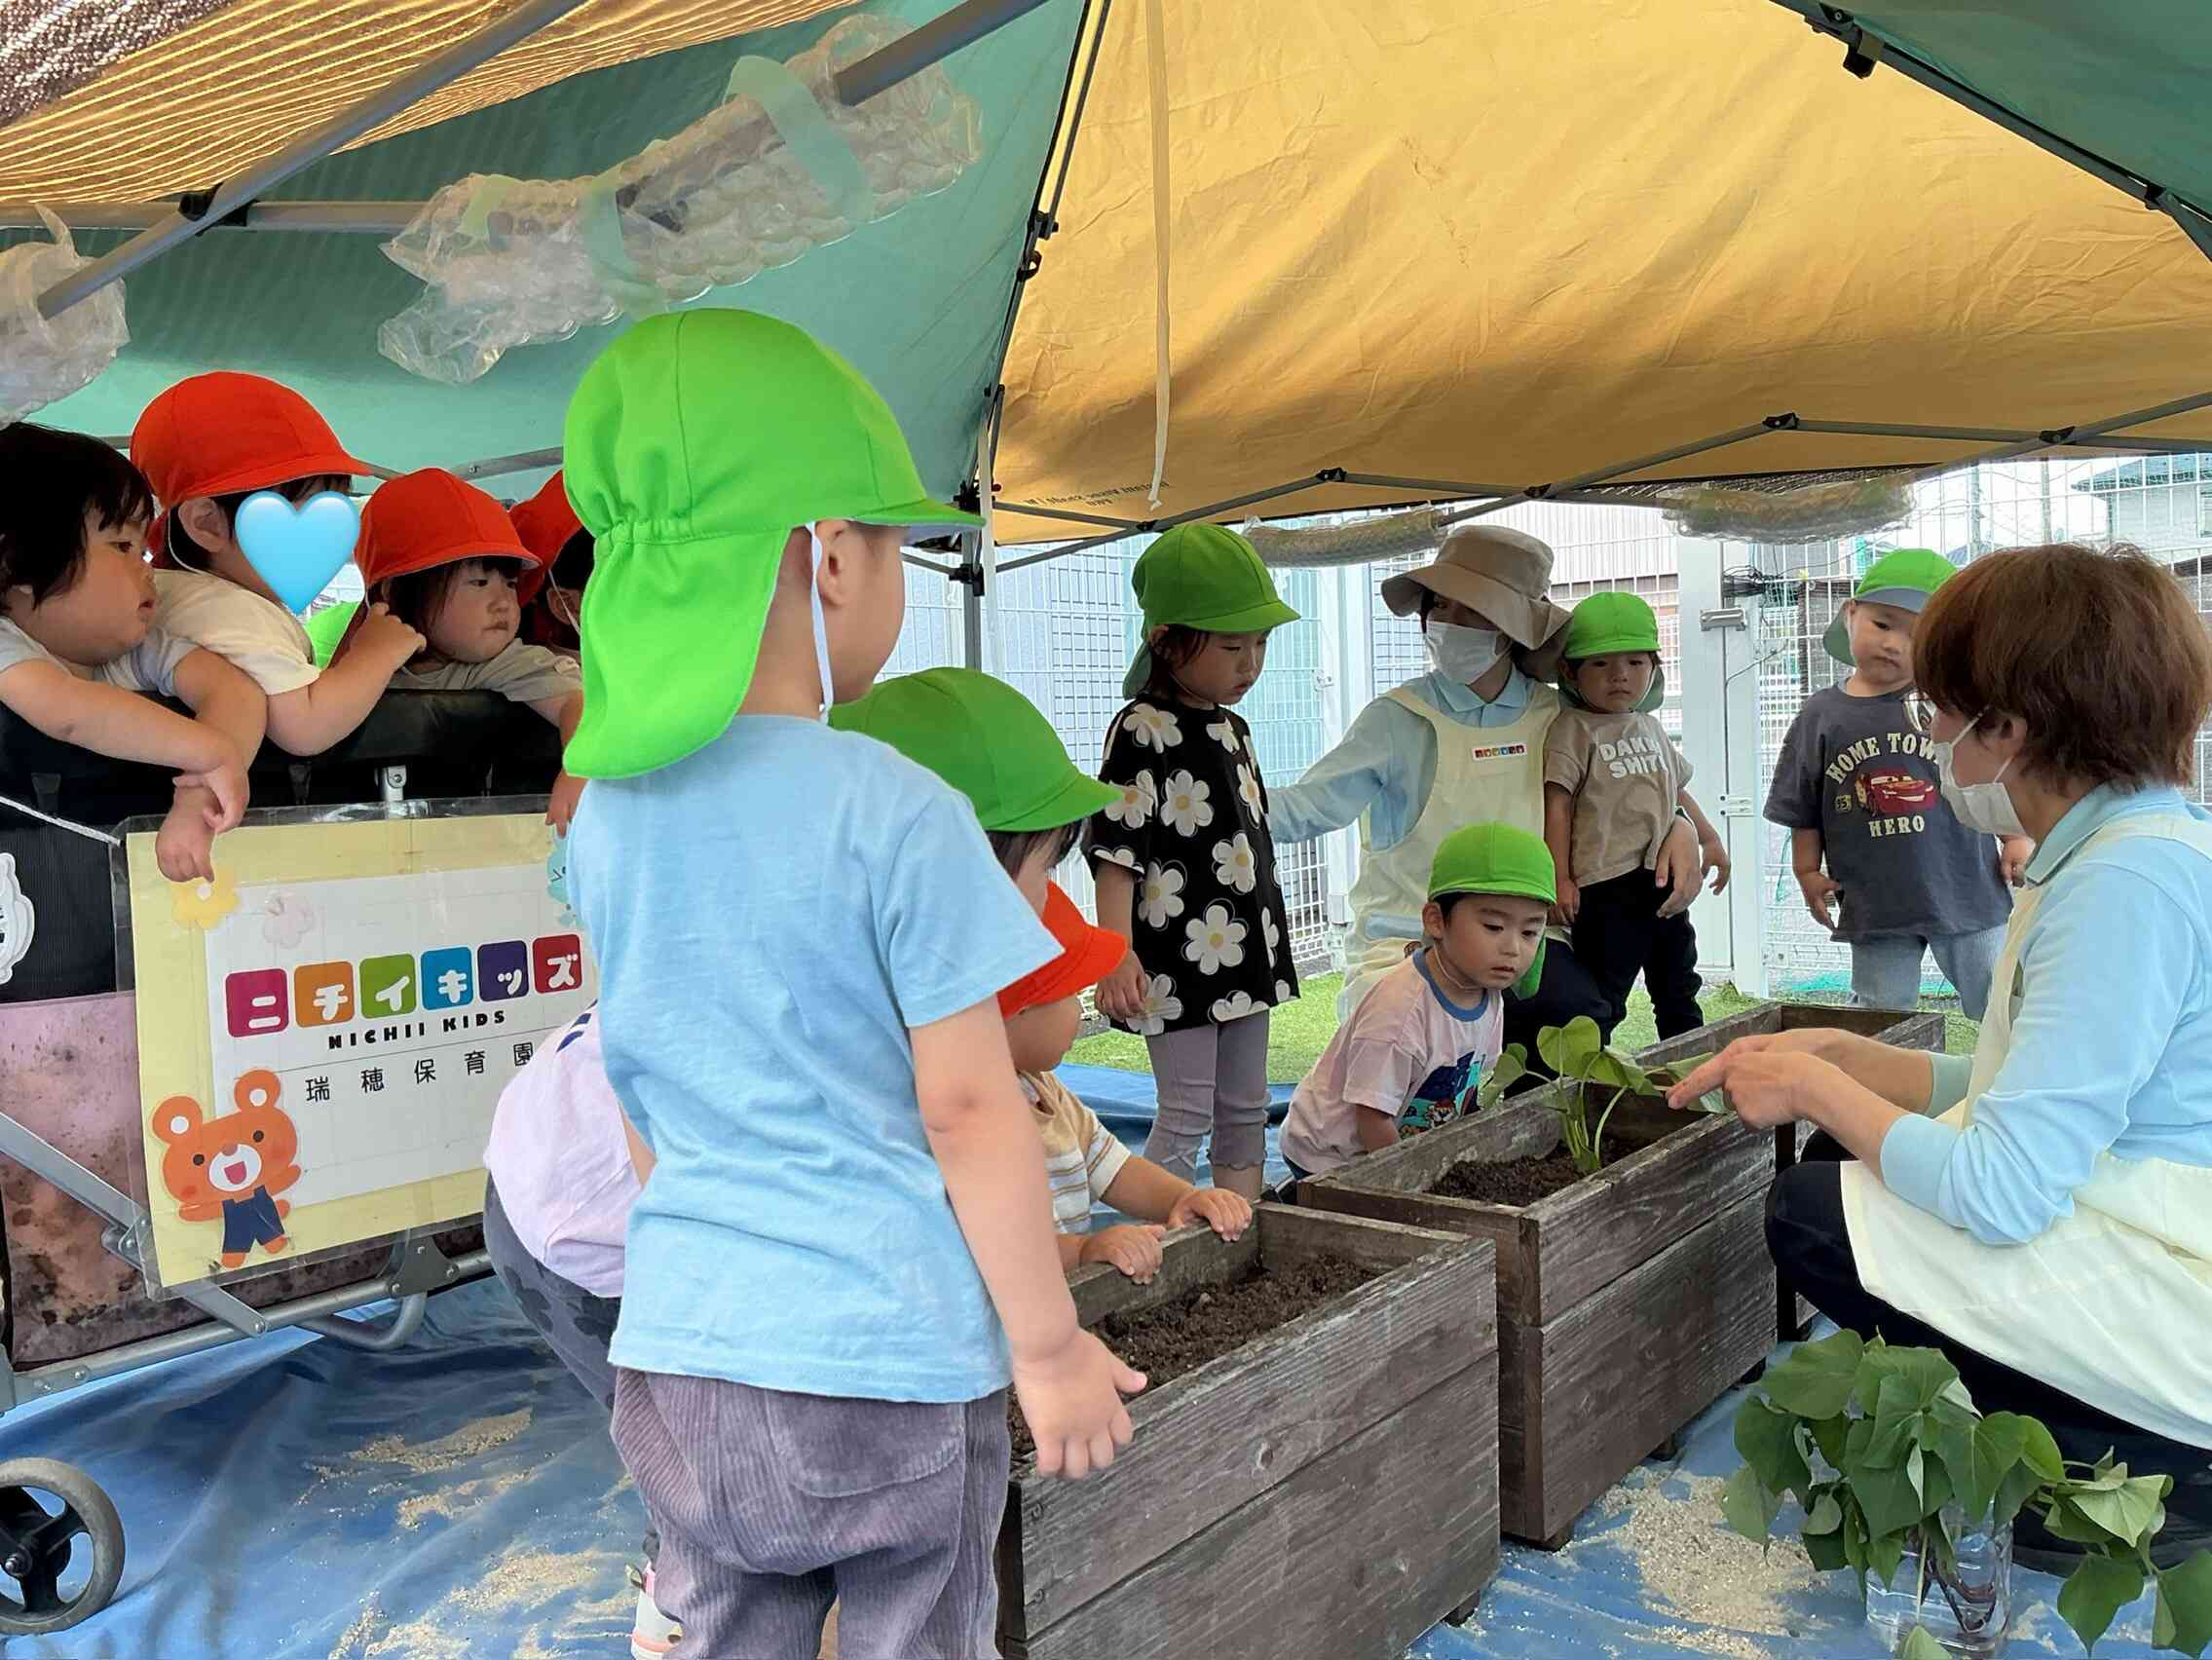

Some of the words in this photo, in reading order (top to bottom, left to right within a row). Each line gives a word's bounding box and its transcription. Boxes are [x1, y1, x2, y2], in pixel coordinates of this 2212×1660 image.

[1825, 736, 1881, 784] HOME
[1887, 732, 1938, 765] TOW
[1868, 814, 1926, 838] HERO
[245, 952, 581, 1031] ニチイキッズ
[328, 1022, 426, 1050] NICHII
[442, 1010, 506, 1034] KIDS
[305, 1041, 534, 1103] 瑞穂保育園
